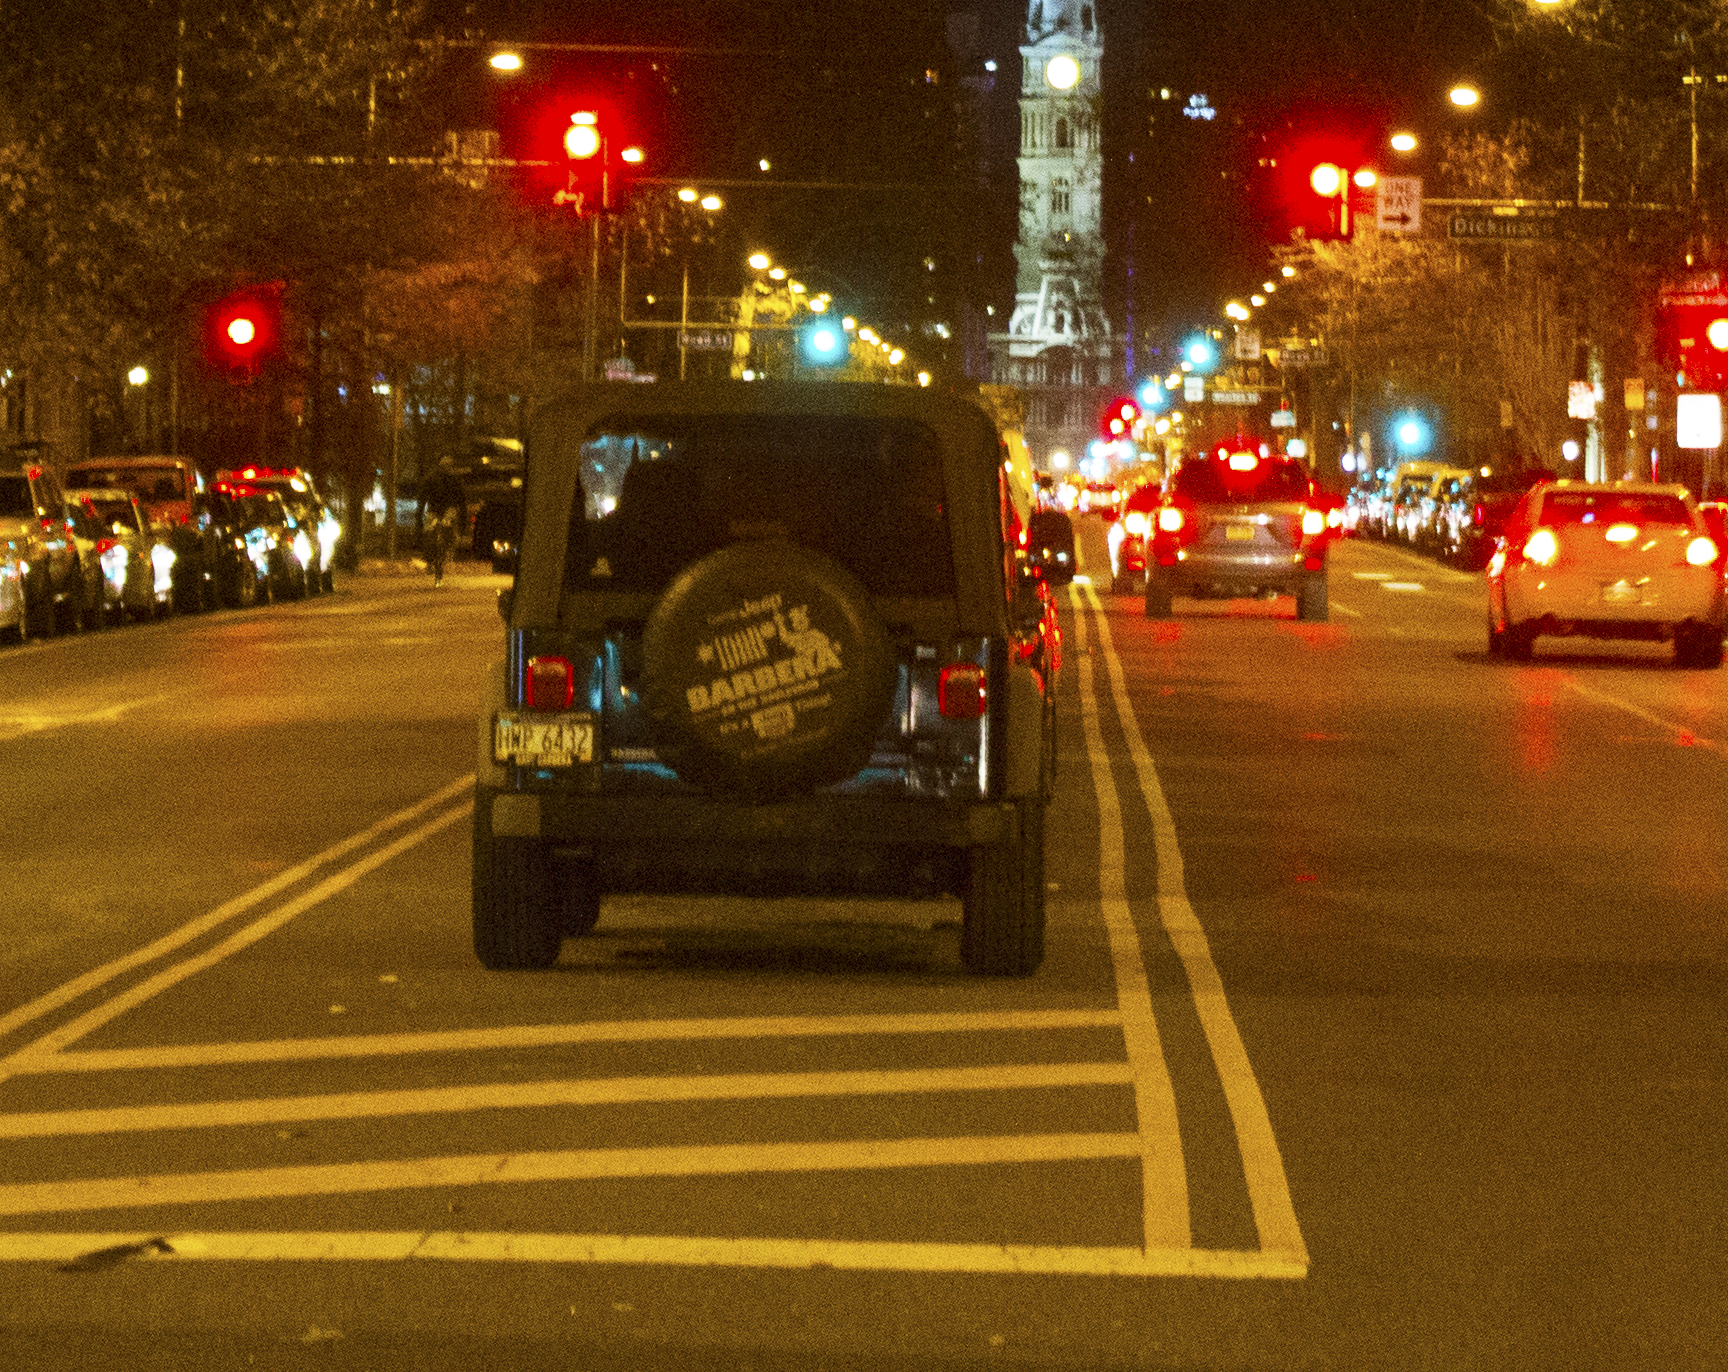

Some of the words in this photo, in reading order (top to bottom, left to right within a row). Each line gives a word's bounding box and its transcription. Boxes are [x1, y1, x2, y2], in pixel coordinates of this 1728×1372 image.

[1385, 181, 1411, 195] ONE
[1384, 195, 1414, 209] WAY
[685, 645, 843, 714] BARBERA
